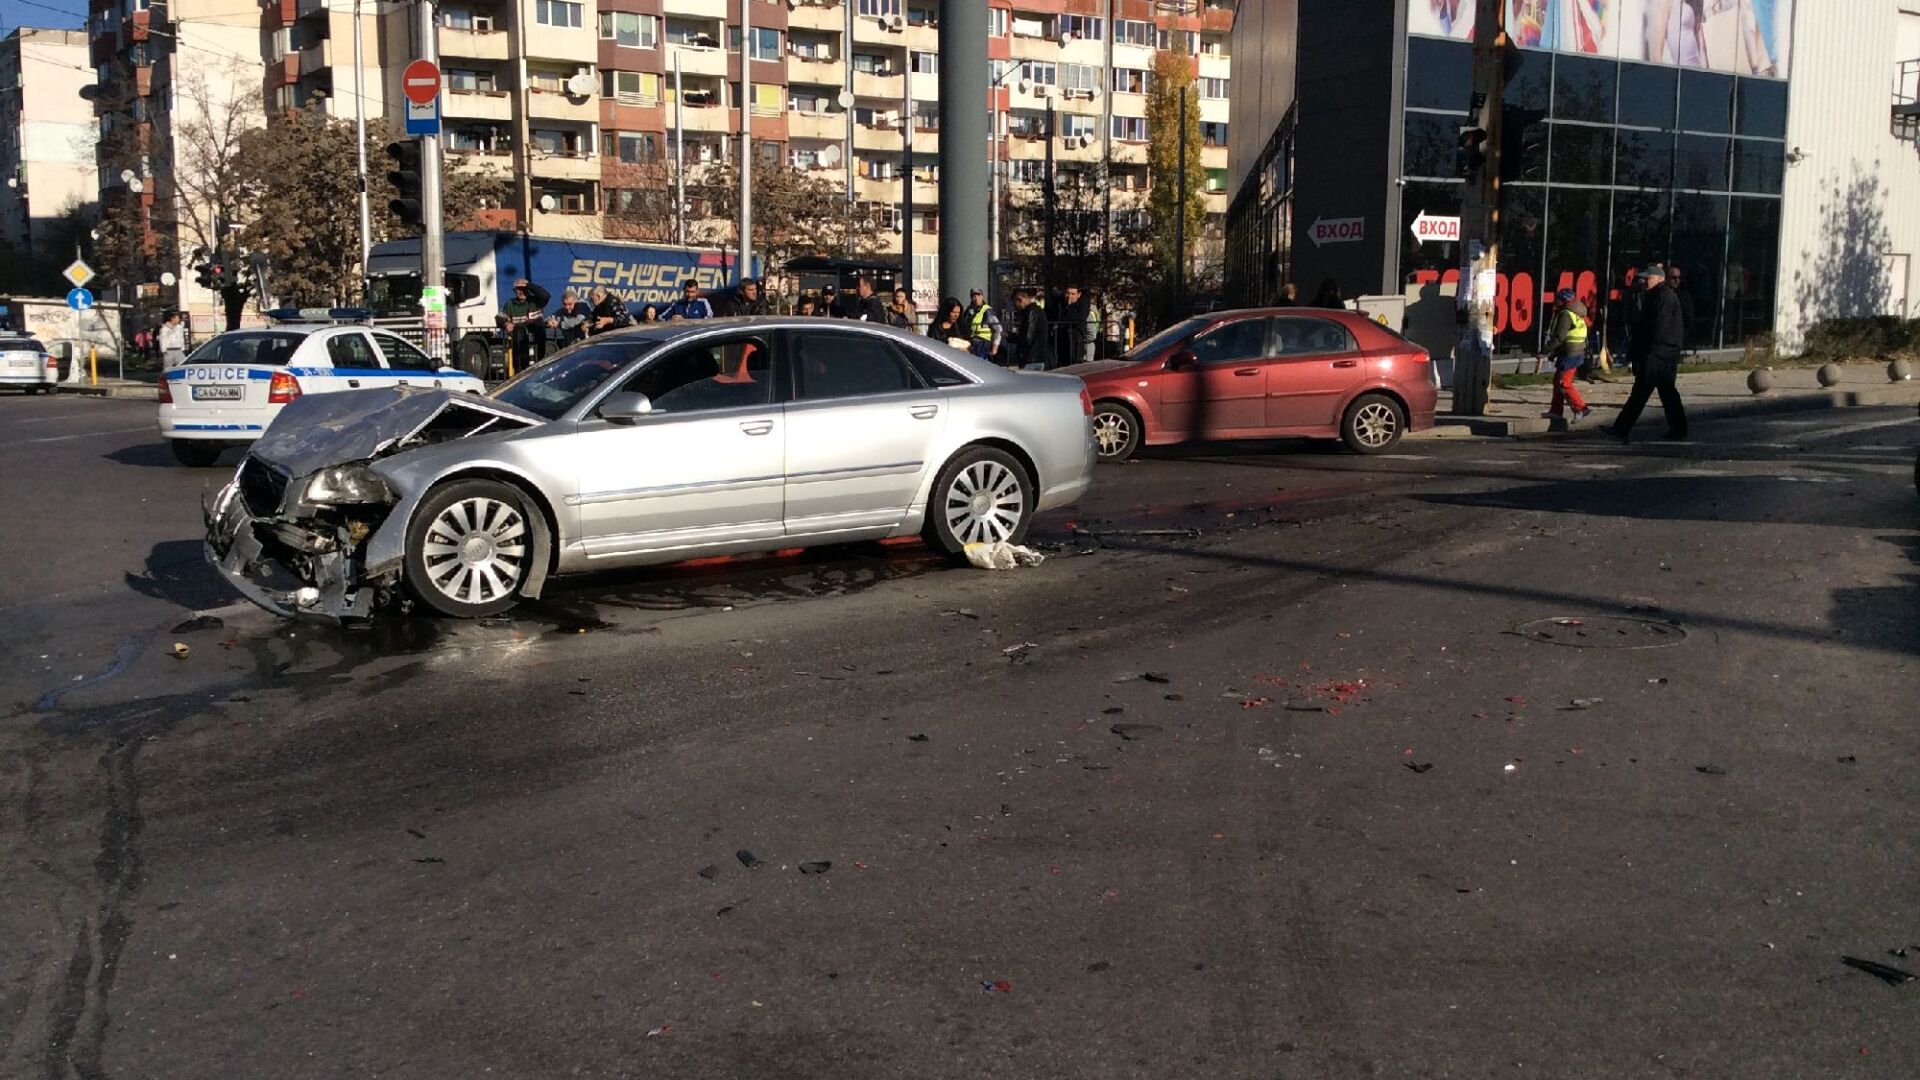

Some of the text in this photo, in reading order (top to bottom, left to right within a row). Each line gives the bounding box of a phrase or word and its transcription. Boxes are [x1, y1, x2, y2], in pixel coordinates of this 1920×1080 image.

[1316, 221, 1363, 239] ВХОД
[1419, 220, 1458, 237] ВХОД
[566, 284, 684, 304] NTNATIONA
[187, 368, 245, 380] POLICE
